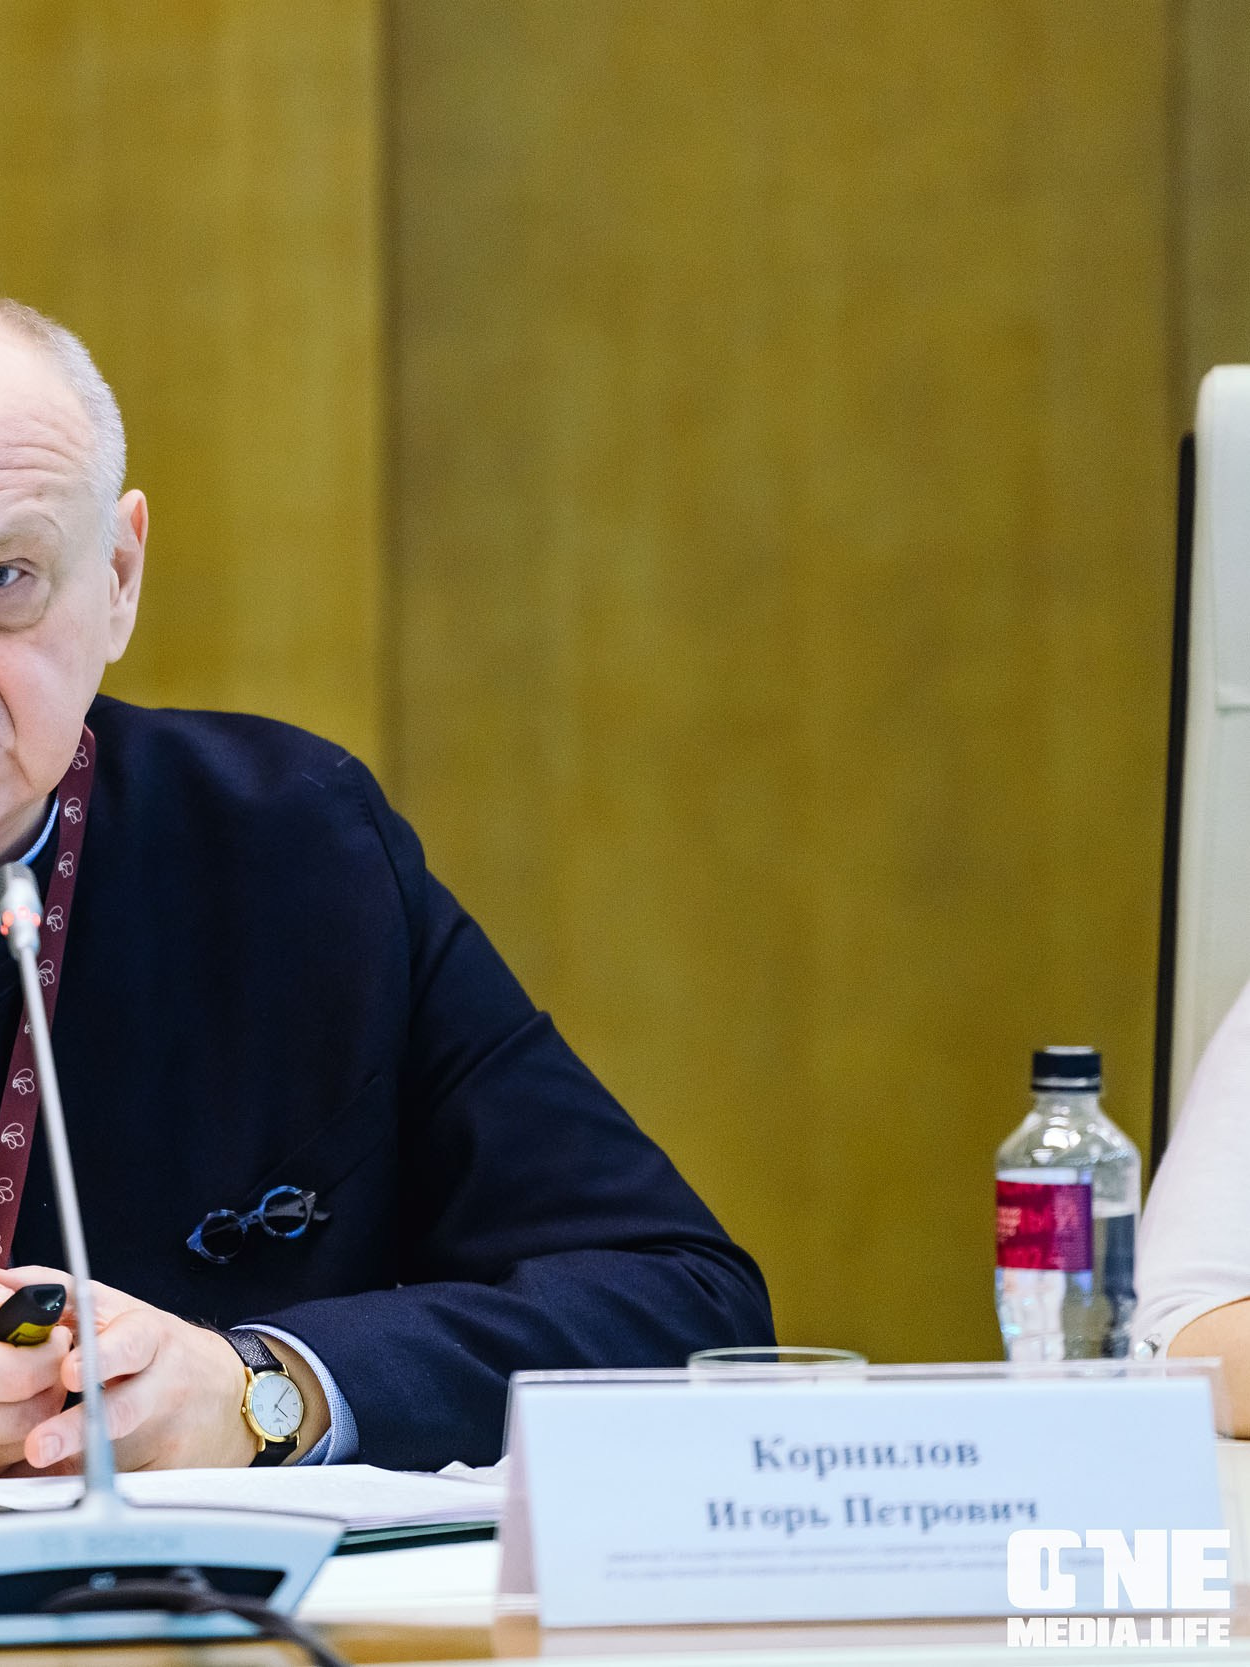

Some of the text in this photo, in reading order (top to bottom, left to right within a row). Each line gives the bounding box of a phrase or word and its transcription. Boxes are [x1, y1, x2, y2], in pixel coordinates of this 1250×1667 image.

[751, 1436, 981, 1479] Корнилов
[706, 1496, 1039, 1535] Игорь Петрович
